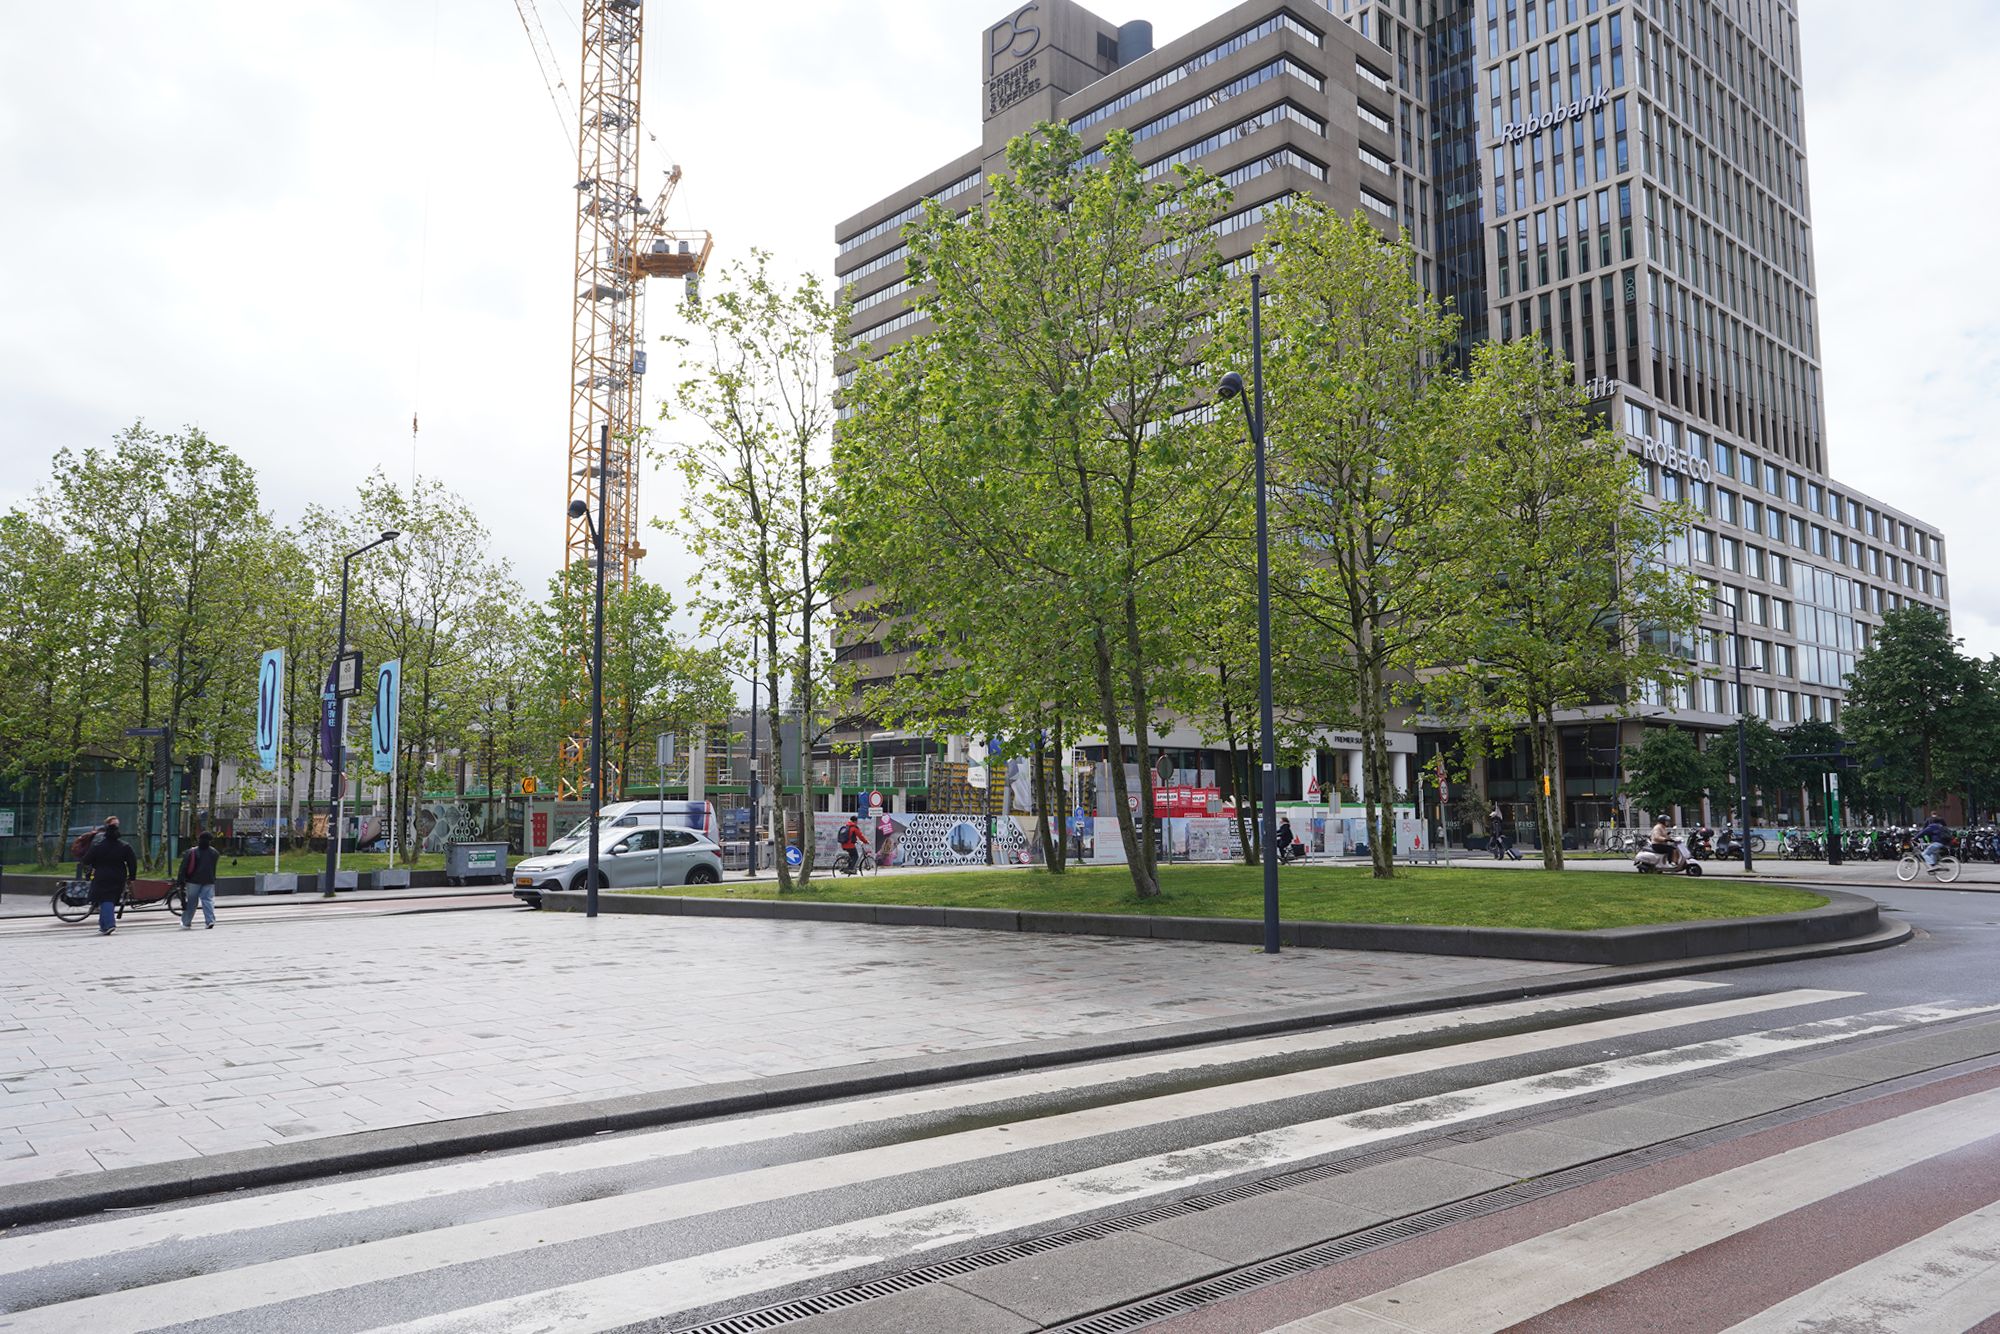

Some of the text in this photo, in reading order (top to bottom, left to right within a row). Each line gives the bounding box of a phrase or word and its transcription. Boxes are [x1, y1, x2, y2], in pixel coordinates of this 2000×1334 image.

[989, 5, 1040, 76] PS
[989, 58, 1037, 92] PREMIER
[989, 74, 1029, 103] SUITES
[999, 77, 1041, 109] OFFICES
[1500, 86, 1610, 146] Rabobank
[1625, 277, 1636, 303] BDO
[1644, 434, 1711, 483] ROBECO
